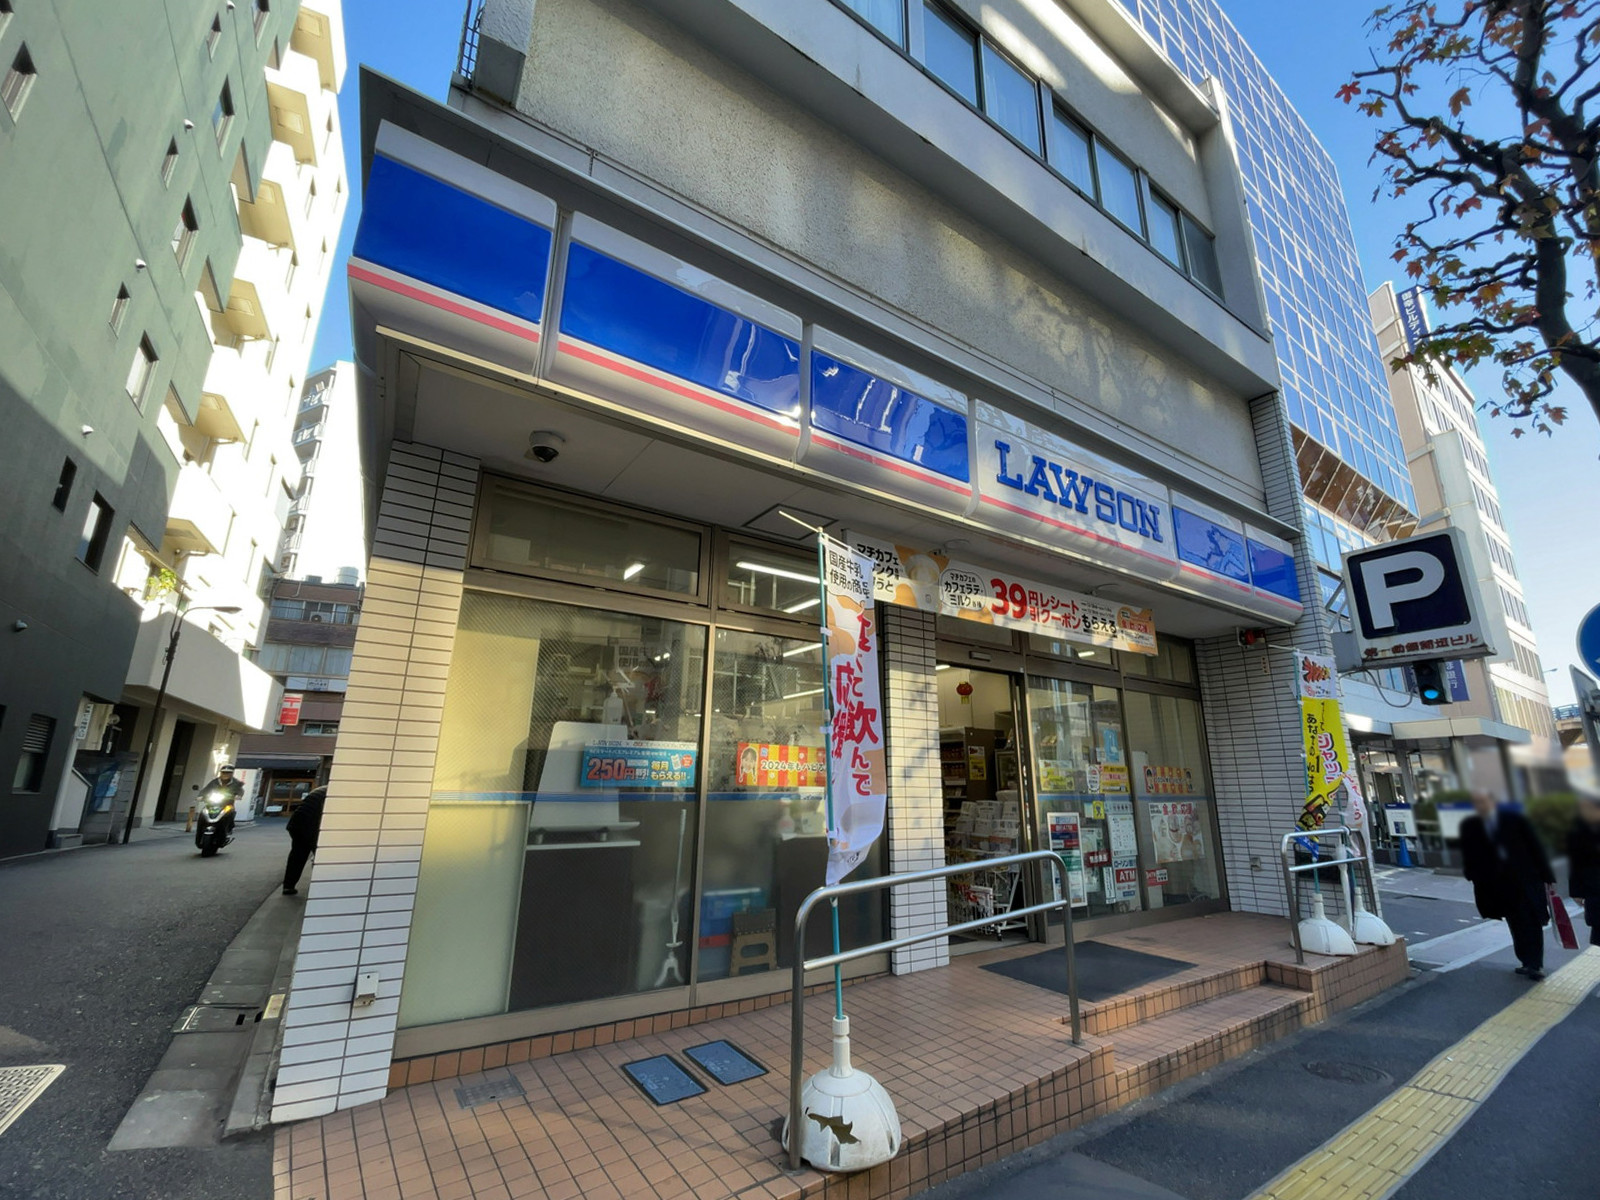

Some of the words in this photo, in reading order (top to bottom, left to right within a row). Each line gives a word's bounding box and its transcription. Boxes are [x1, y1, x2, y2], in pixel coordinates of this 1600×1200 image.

[994, 439, 1163, 543] LAWSON
[830, 568, 870, 599] 使用の商品
[1360, 551, 1445, 630] P
[990, 578, 1028, 619] 39
[1028, 590, 1080, 614] 円レシート
[1029, 606, 1081, 630] 引クーポン
[1081, 614, 1117, 634] もらえる
[1120, 870, 1136, 881] ATM
